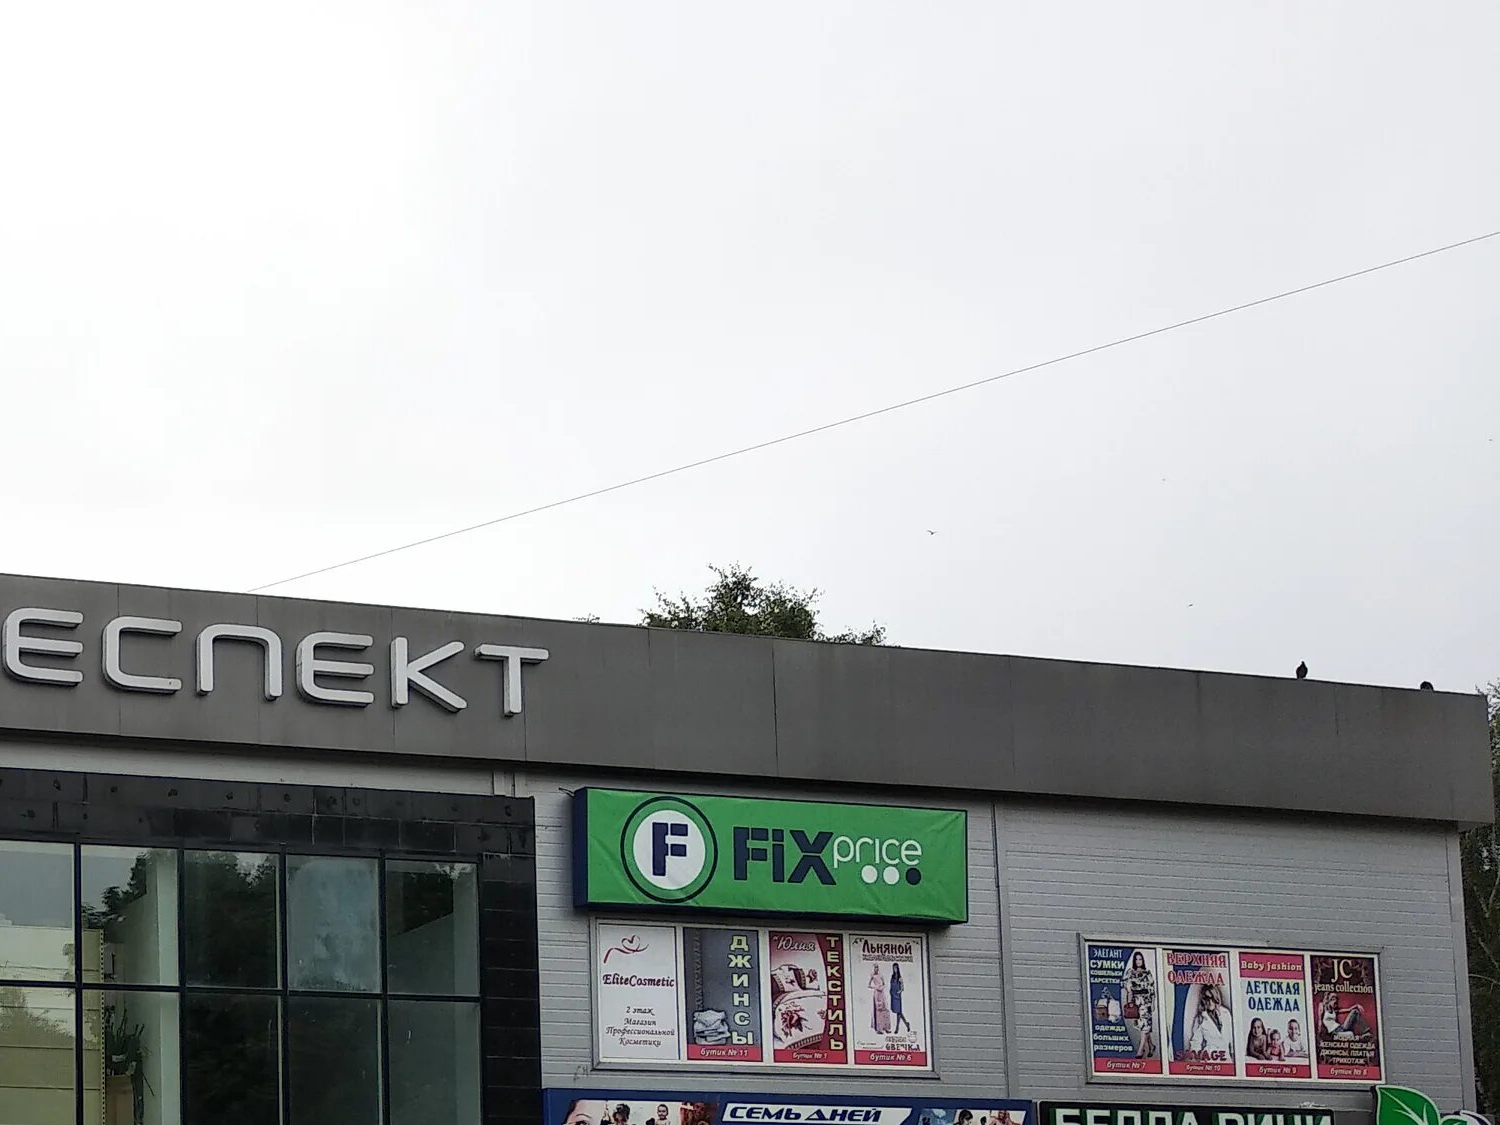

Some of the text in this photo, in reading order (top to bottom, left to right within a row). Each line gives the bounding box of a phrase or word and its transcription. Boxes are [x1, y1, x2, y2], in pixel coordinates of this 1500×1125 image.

[833, 836, 923, 869] price
[1090, 960, 1125, 970] СУМКИ
[1166, 952, 1227, 968] ВЕРХНЯЯ
[1240, 960, 1303, 972] Baby fashion
[1331, 958, 1354, 983] JC
[602, 972, 675, 987] EliteCosmetic
[1167, 970, 1226, 986] ОДЕЖДА
[728, 934, 755, 1046] ДЖИНСЫ
[826, 936, 845, 1051] ТЕКСТИЛЬ
[1245, 980, 1301, 996] ДЕТСКАЯ
[1335, 981, 1374, 994] collection
[1248, 996, 1301, 1013] ОДЕЖДА
[624, 1018, 656, 1026] Магазин
[605, 1026, 675, 1038] Профессиональной
[618, 1037, 662, 1047] Косметики
[1093, 1044, 1133, 1053] размеров
[700, 1047, 727, 1057] бутик
[869, 1053, 895, 1062] бутик
[1106, 1061, 1131, 1070] бутик
[729, 1106, 882, 1123] СЕМЬ ДНЕЙ
